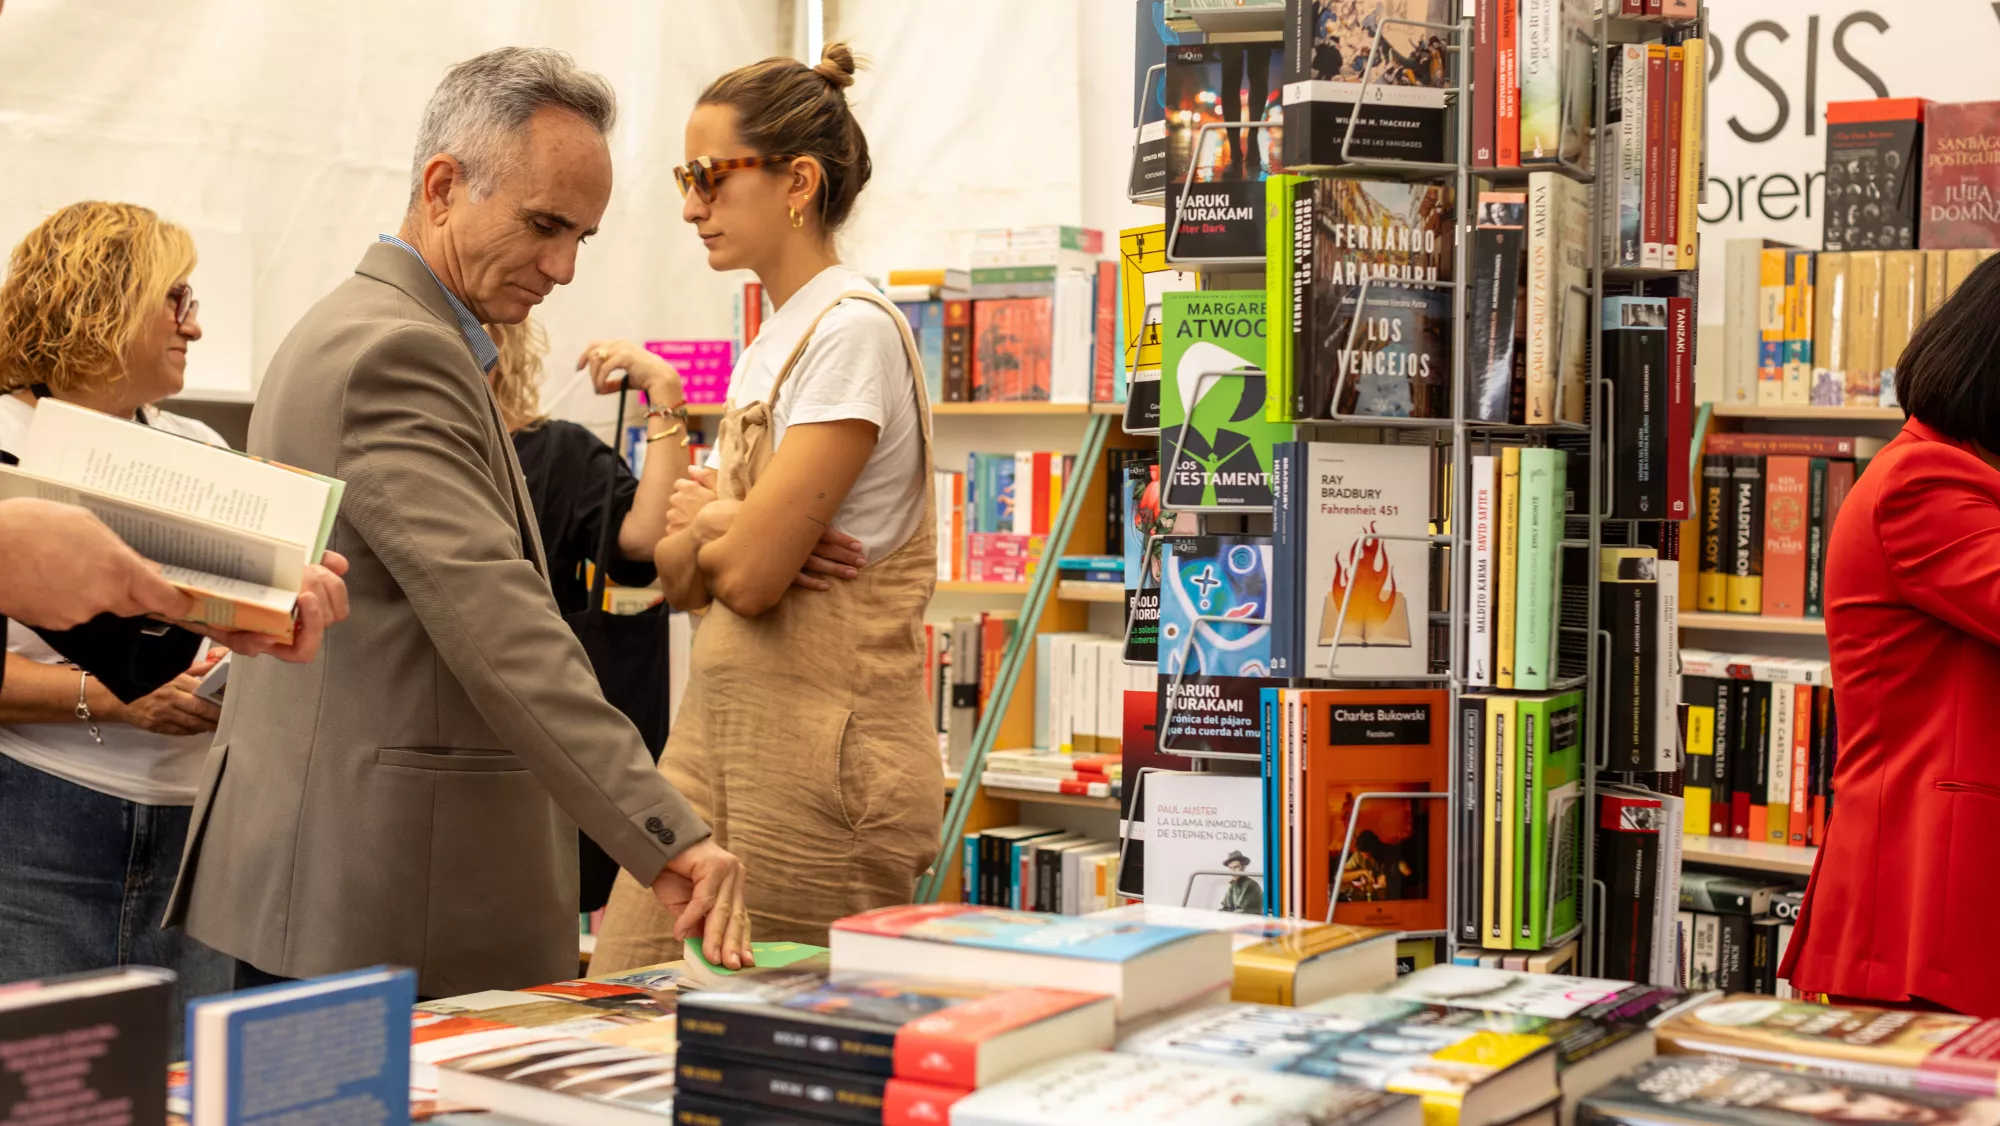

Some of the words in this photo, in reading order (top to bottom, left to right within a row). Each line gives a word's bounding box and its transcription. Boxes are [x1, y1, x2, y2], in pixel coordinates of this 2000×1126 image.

[1506, 48, 1514, 58] LA
[1529, 30, 1539, 75] CARLOS
[1506, 58, 1514, 95] BIBLIOTECA
[1624, 67, 1635, 105] ZAFÓN
[1506, 95, 1514, 104] DE
[1506, 105, 1514, 118] LOS
[1335, 116, 1367, 126] WILAM
[1368, 118, 1378, 126] M.
[1379, 118, 1421, 128] THACKERAY
[1624, 106, 1634, 135] RUIZ
[1157, 151, 1166, 160] PÉR
[1362, 138, 1371, 146] DE
[1372, 138, 1385, 146] LAS
[1385, 140, 1423, 148] VANIDADES
[1622, 137, 1634, 181] CARLOS
[1670, 148, 1678, 176] PROFESOR
[1175, 194, 1230, 208] HARUKI
[1945, 183, 1992, 203] JULIA
[1175, 207, 1253, 222] MURAKAMI
[1535, 185, 1547, 238] MARINA
[1201, 223, 1227, 233] Dark
[1294, 199, 1303, 264] ARAMBURU
[1302, 198, 1313, 257] VENCEJOS
[1335, 223, 1435, 254] FERNANDO
[1650, 228, 1656, 236] LA
[1302, 268, 1312, 285] LOS
[1331, 260, 1438, 291] ARAMBURU
[1534, 245, 1546, 292] ZAFÓN
[1293, 271, 1303, 333] FERNANDO
[1491, 279, 1500, 309] ALMUDENA
[1187, 302, 1267, 316] MARGARE
[1534, 295, 1546, 326] RUIZ
[1176, 318, 1267, 339] ATWOO
[1367, 316, 1402, 342] LOS
[1675, 308, 1686, 353] TANIZAKI
[1336, 349, 1431, 378] VENCEJOS
[1533, 328, 1544, 384] CARLOS
[1176, 460, 1197, 470] LOS
[1173, 472, 1274, 486] TESTAMENT
[1273, 459, 1281, 498] HUXLEY
[1321, 474, 1344, 486] RAY
[1321, 487, 1382, 500] BRADBURY
[1478, 489, 1488, 521] SAFIER
[1320, 503, 1377, 516] Fahrenheit
[1379, 504, 1399, 516] 451
[1506, 492, 1514, 524] ORWELL
[1708, 487, 1721, 532] ROMA
[1738, 483, 1752, 548] MALDITA
[1477, 523, 1488, 552] DAVID
[1506, 526, 1514, 556] GEORGE
[1706, 535, 1719, 562] SOY
[1478, 559, 1487, 592] KARMA
[1130, 596, 1158, 609] PAOLO
[1130, 608, 1161, 621] IORDA
[1476, 593, 1487, 634] MALDITO
[1634, 600, 1642, 625] GRANDES
[1633, 655, 1642, 675] GARCÍA
[1166, 683, 1220, 698] HARUKI
[1633, 675, 1641, 696] DOCTOR
[1718, 686, 1728, 699] EL
[1165, 696, 1244, 712] MURAKAMI
[1334, 709, 1376, 723] Charles
[1377, 709, 1426, 722] Bukowski
[1778, 688, 1786, 725] JAVIER
[1168, 714, 1202, 725] rónica
[1203, 715, 1219, 725] del
[1220, 716, 1252, 727] pájaro
[1184, 726, 1197, 735] da
[1198, 727, 1232, 736] cuerda
[1233, 728, 1244, 737] al
[1468, 729, 1474, 737] un
[1496, 716, 1505, 735] negro
[1526, 716, 1534, 745] territorio
[1468, 738, 1474, 746] en
[1775, 726, 1786, 779] CASTILLO
[1526, 757, 1534, 772] mapa
[1157, 804, 1180, 815] PAUL
[1182, 806, 1218, 816] AUSTER
[1157, 817, 1170, 826] LA
[1171, 817, 1204, 827] LLAMA
[1205, 819, 1253, 830] INMORTAL
[1157, 829, 1170, 839] DE
[1171, 830, 1213, 840] STEPHEN
[1215, 831, 1248, 842] CRANE
[1674, 810, 1682, 850] MENDOZA
[1635, 849, 1643, 870] PADURA
[1672, 852, 1681, 891] EDUARDO
[1633, 870, 1641, 898] LEONARDO
[1721, 926, 1732, 988] KATZENBACH
[1730, 945, 1740, 972] JOHN
